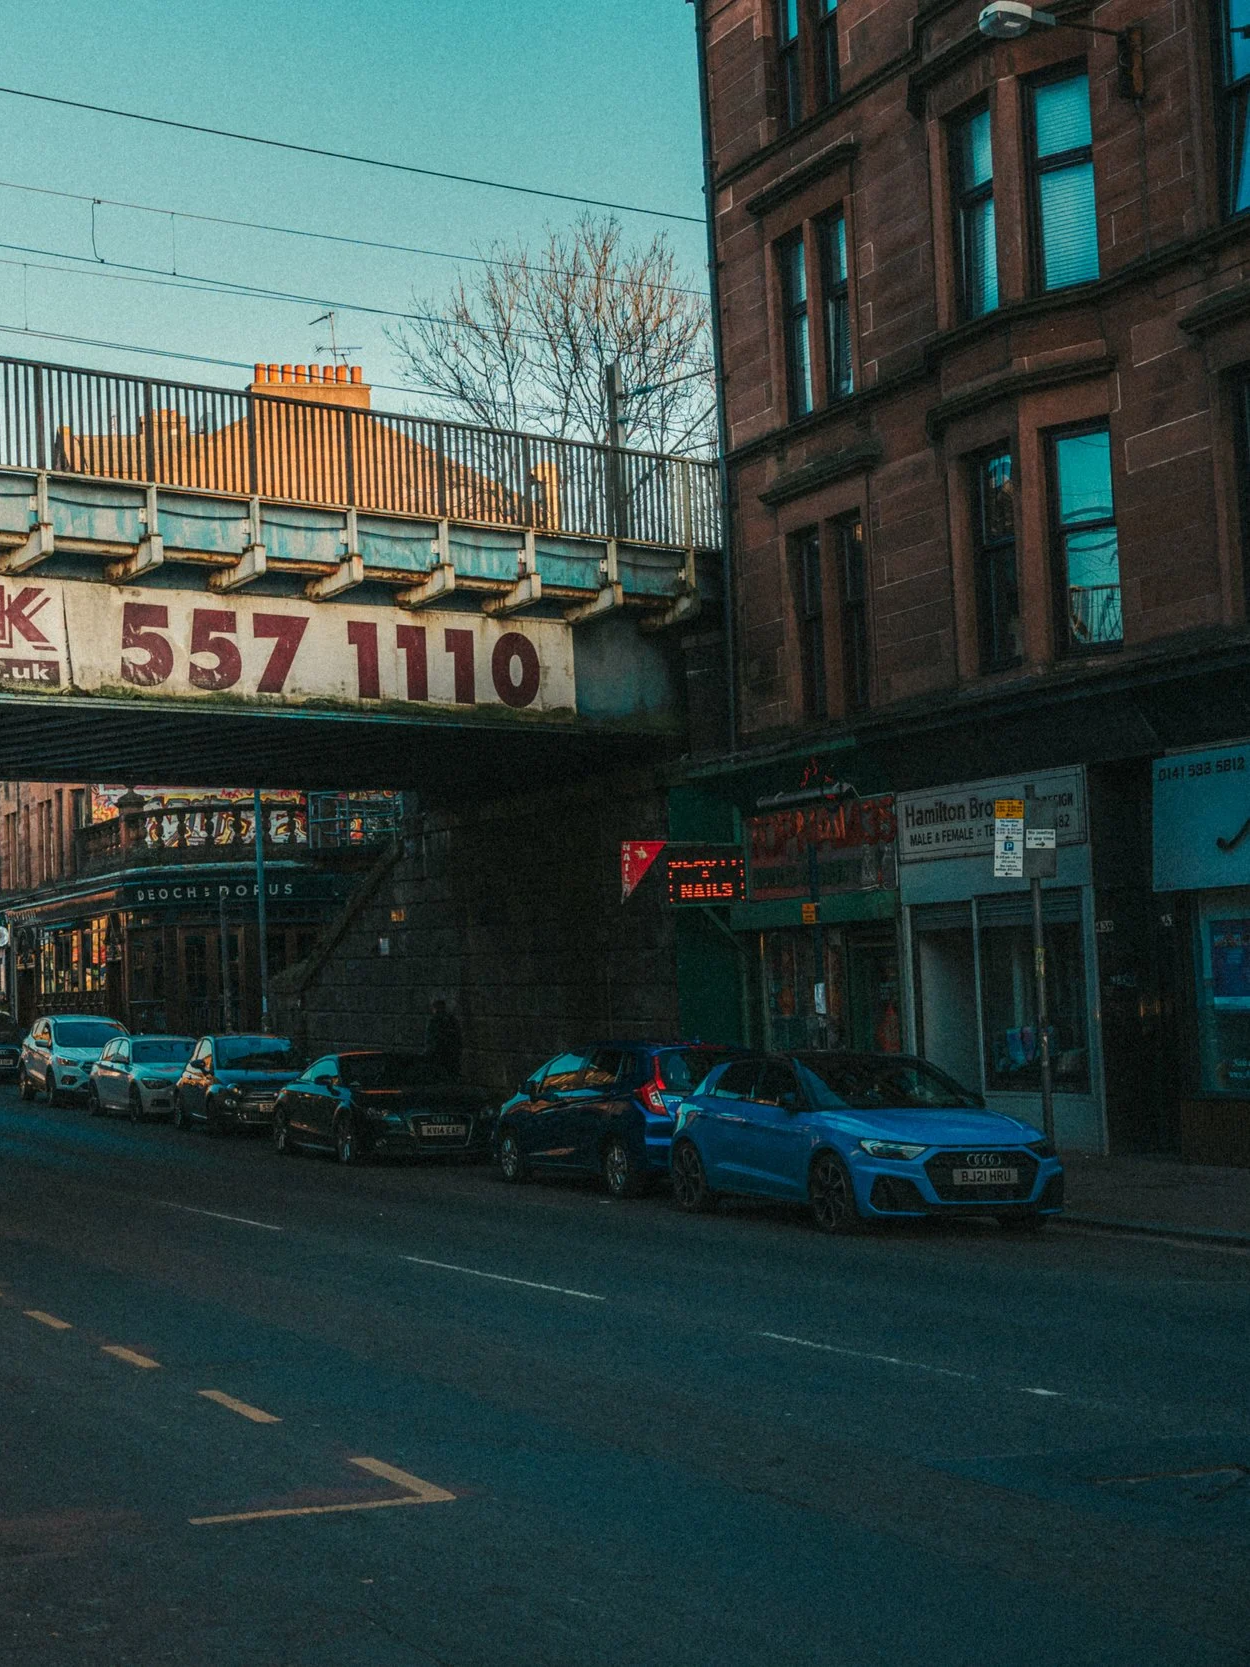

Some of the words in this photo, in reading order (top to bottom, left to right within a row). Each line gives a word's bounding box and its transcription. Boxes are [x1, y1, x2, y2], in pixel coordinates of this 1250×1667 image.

[121, 602, 310, 695] 557
[347, 620, 540, 709] 1110
[905, 800, 966, 829] Hamilton
[910, 833, 932, 847] MALE
[942, 828, 974, 842] FEMALE
[137, 886, 198, 901] DEOCH
[680, 882, 733, 898] NAILS
[961, 1170, 987, 1182] BJ21
[989, 1170, 1011, 1181] HRU
